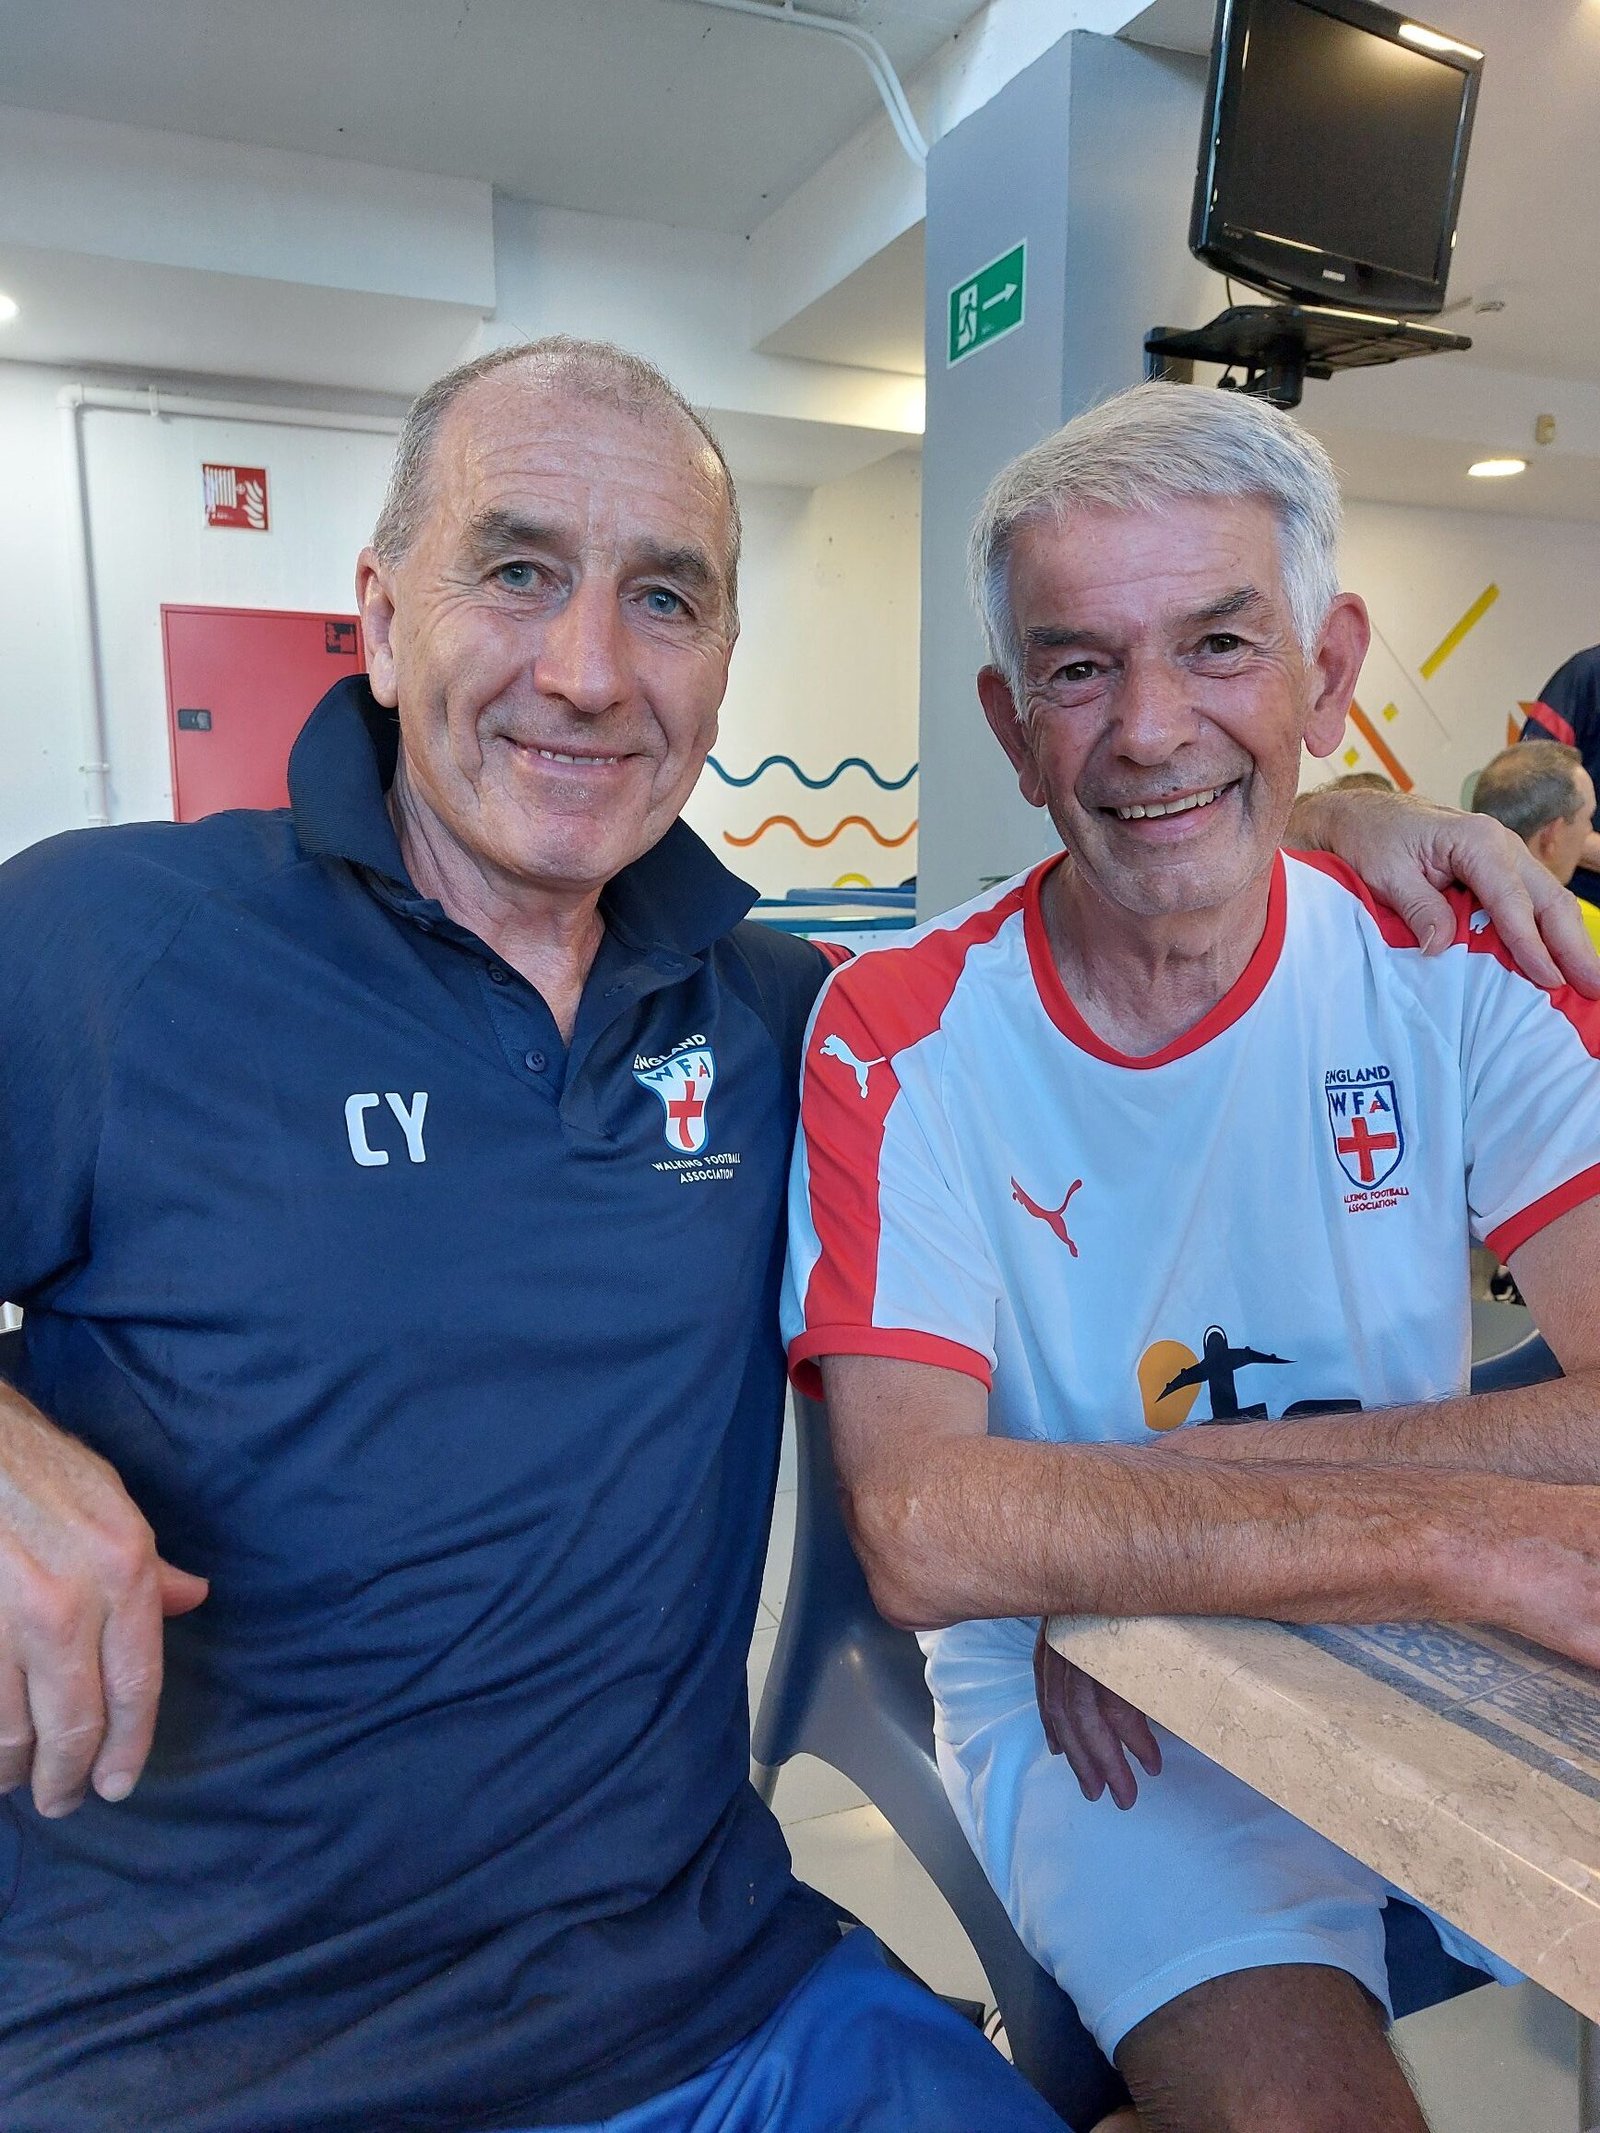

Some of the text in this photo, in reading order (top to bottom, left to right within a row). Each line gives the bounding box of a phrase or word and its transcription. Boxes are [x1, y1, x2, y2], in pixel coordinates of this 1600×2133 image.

[633, 1034, 707, 1070] ENGLAND
[1325, 1065, 1390, 1084] ENGLAND
[344, 1091, 429, 1167] CY
[651, 1153, 741, 1172] WALKING FOOTBALL
[680, 1168, 734, 1184] ASSOCIATION
[1370, 1187, 1410, 1199] FOOTBALL
[1349, 1198, 1397, 1213] ASSOCIATION
